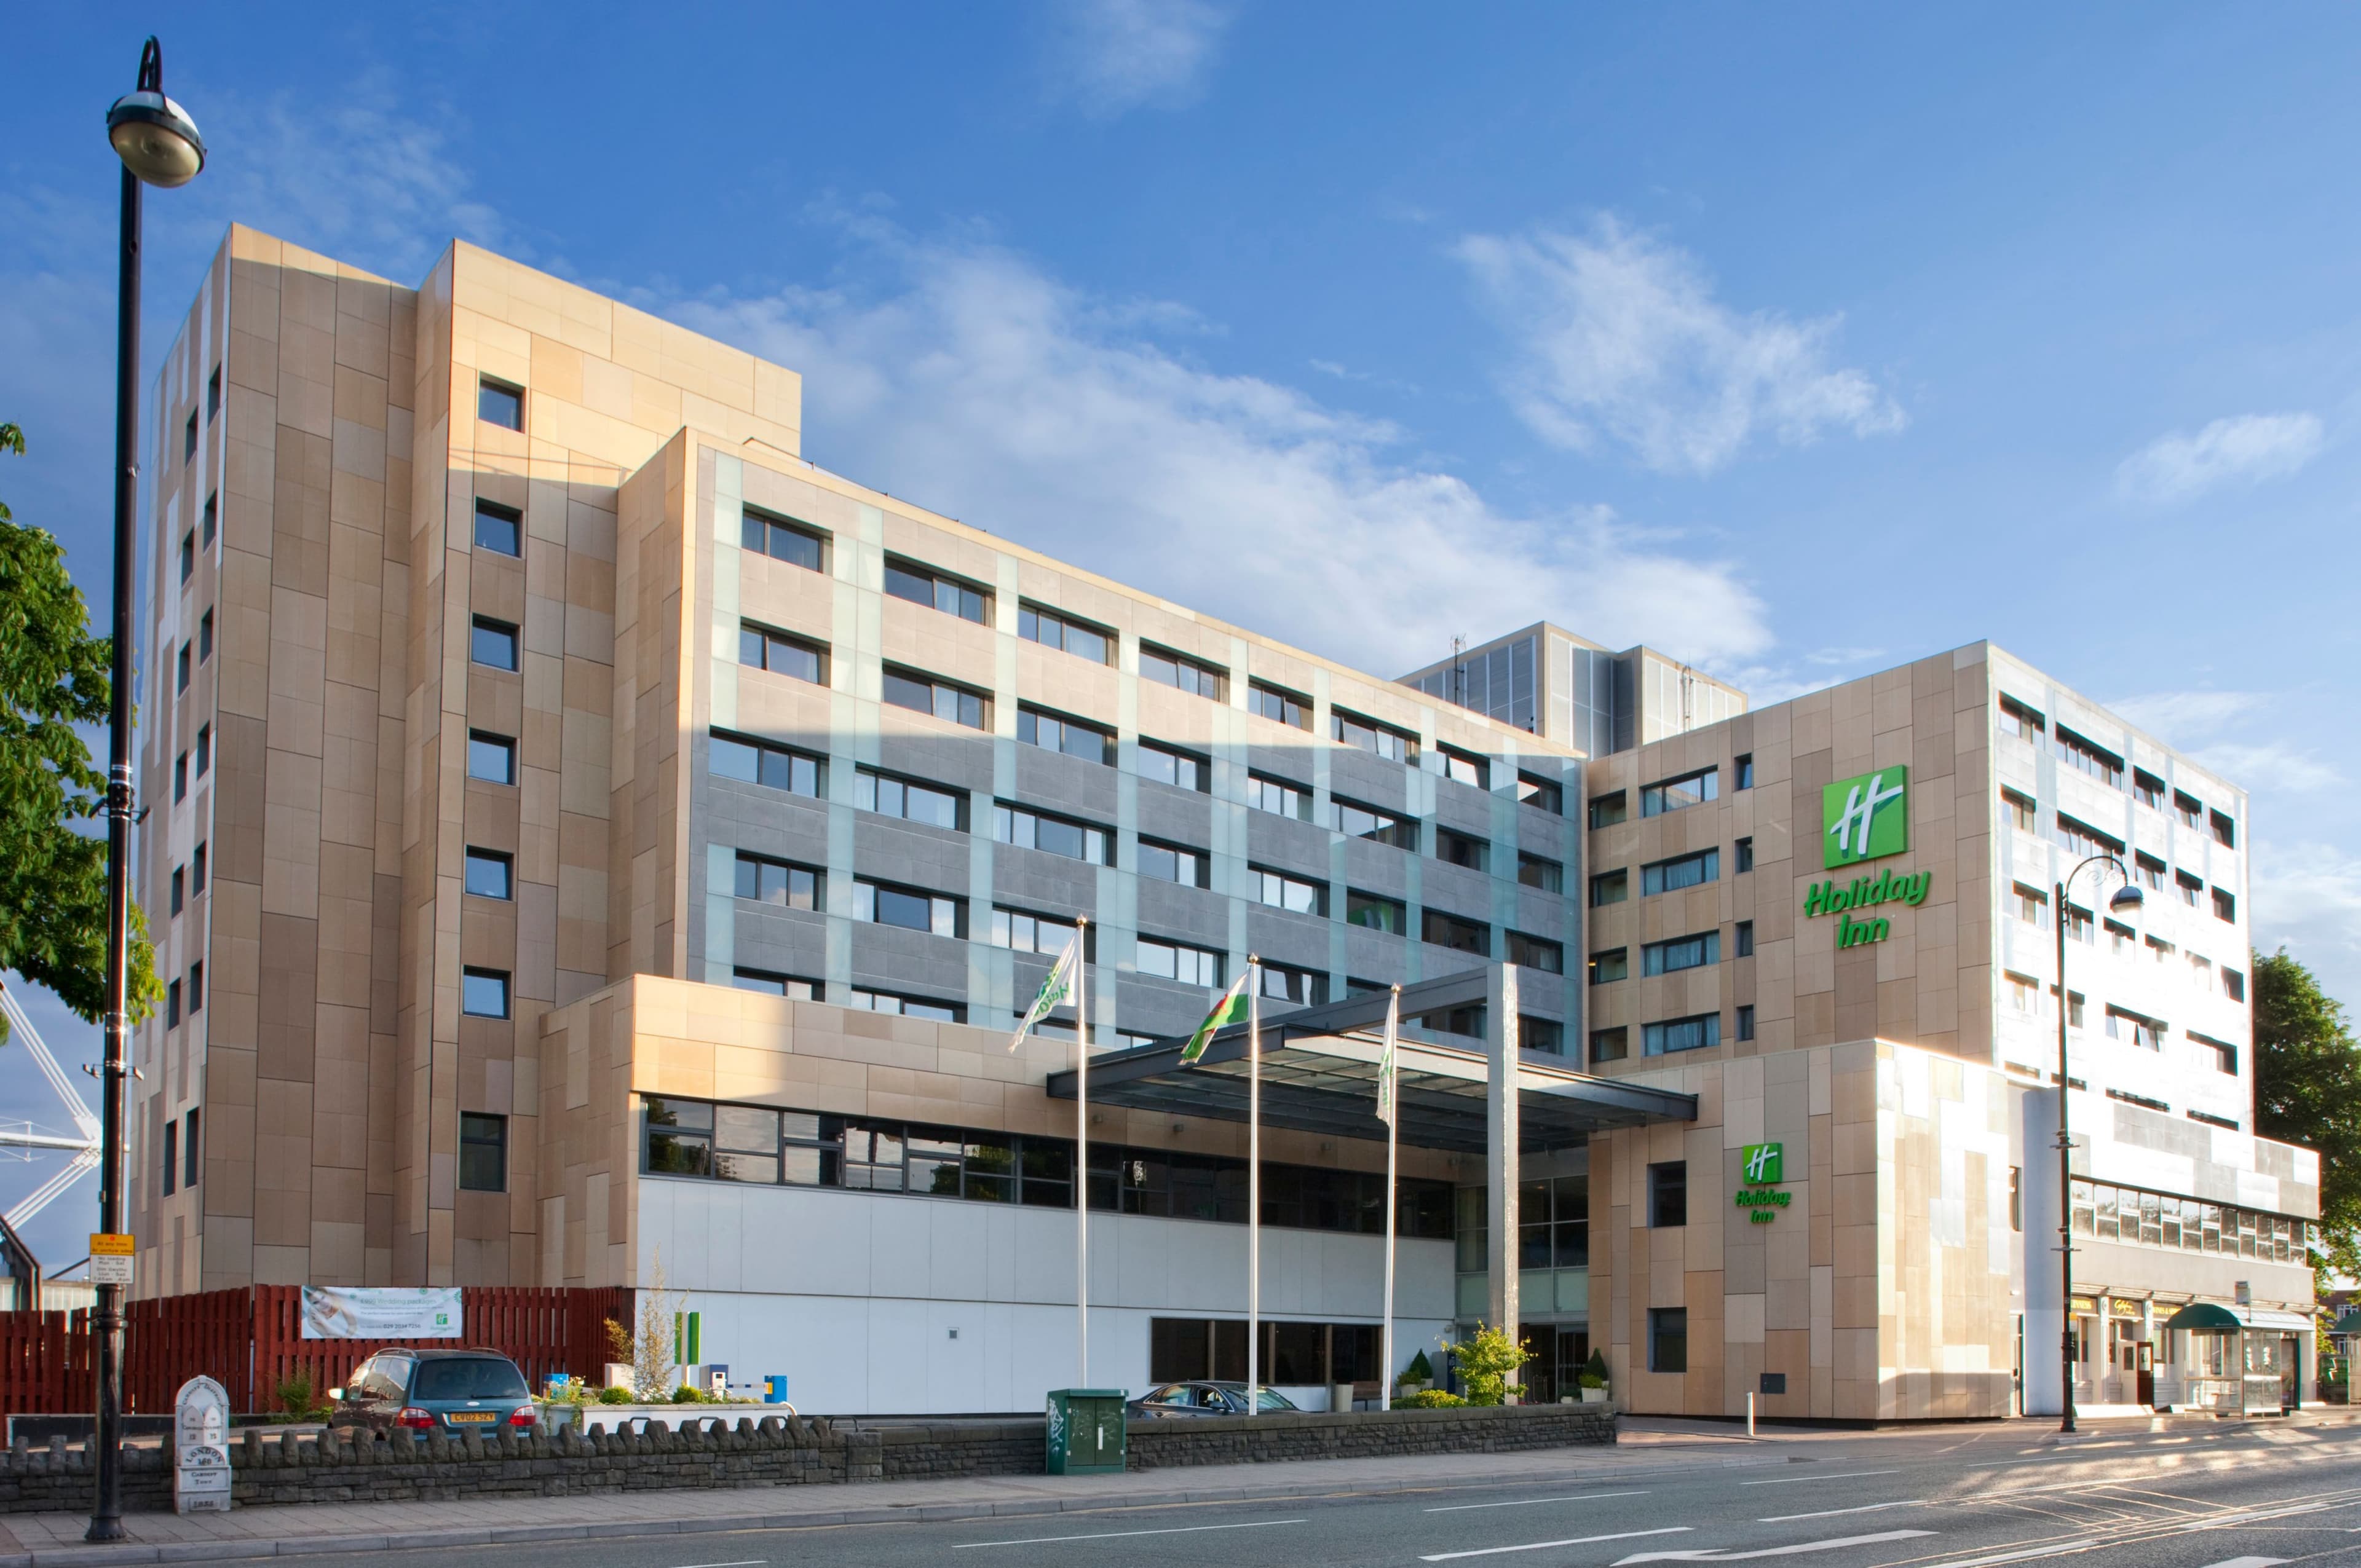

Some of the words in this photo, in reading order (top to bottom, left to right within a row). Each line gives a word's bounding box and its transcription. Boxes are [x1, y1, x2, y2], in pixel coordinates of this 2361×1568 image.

[1804, 869, 1931, 917] Holiday
[1837, 915, 1889, 950] Inn
[1735, 1189, 1791, 1208] Holiday
[1750, 1210, 1774, 1223] Inn
[186, 1448, 222, 1463] LONDON
